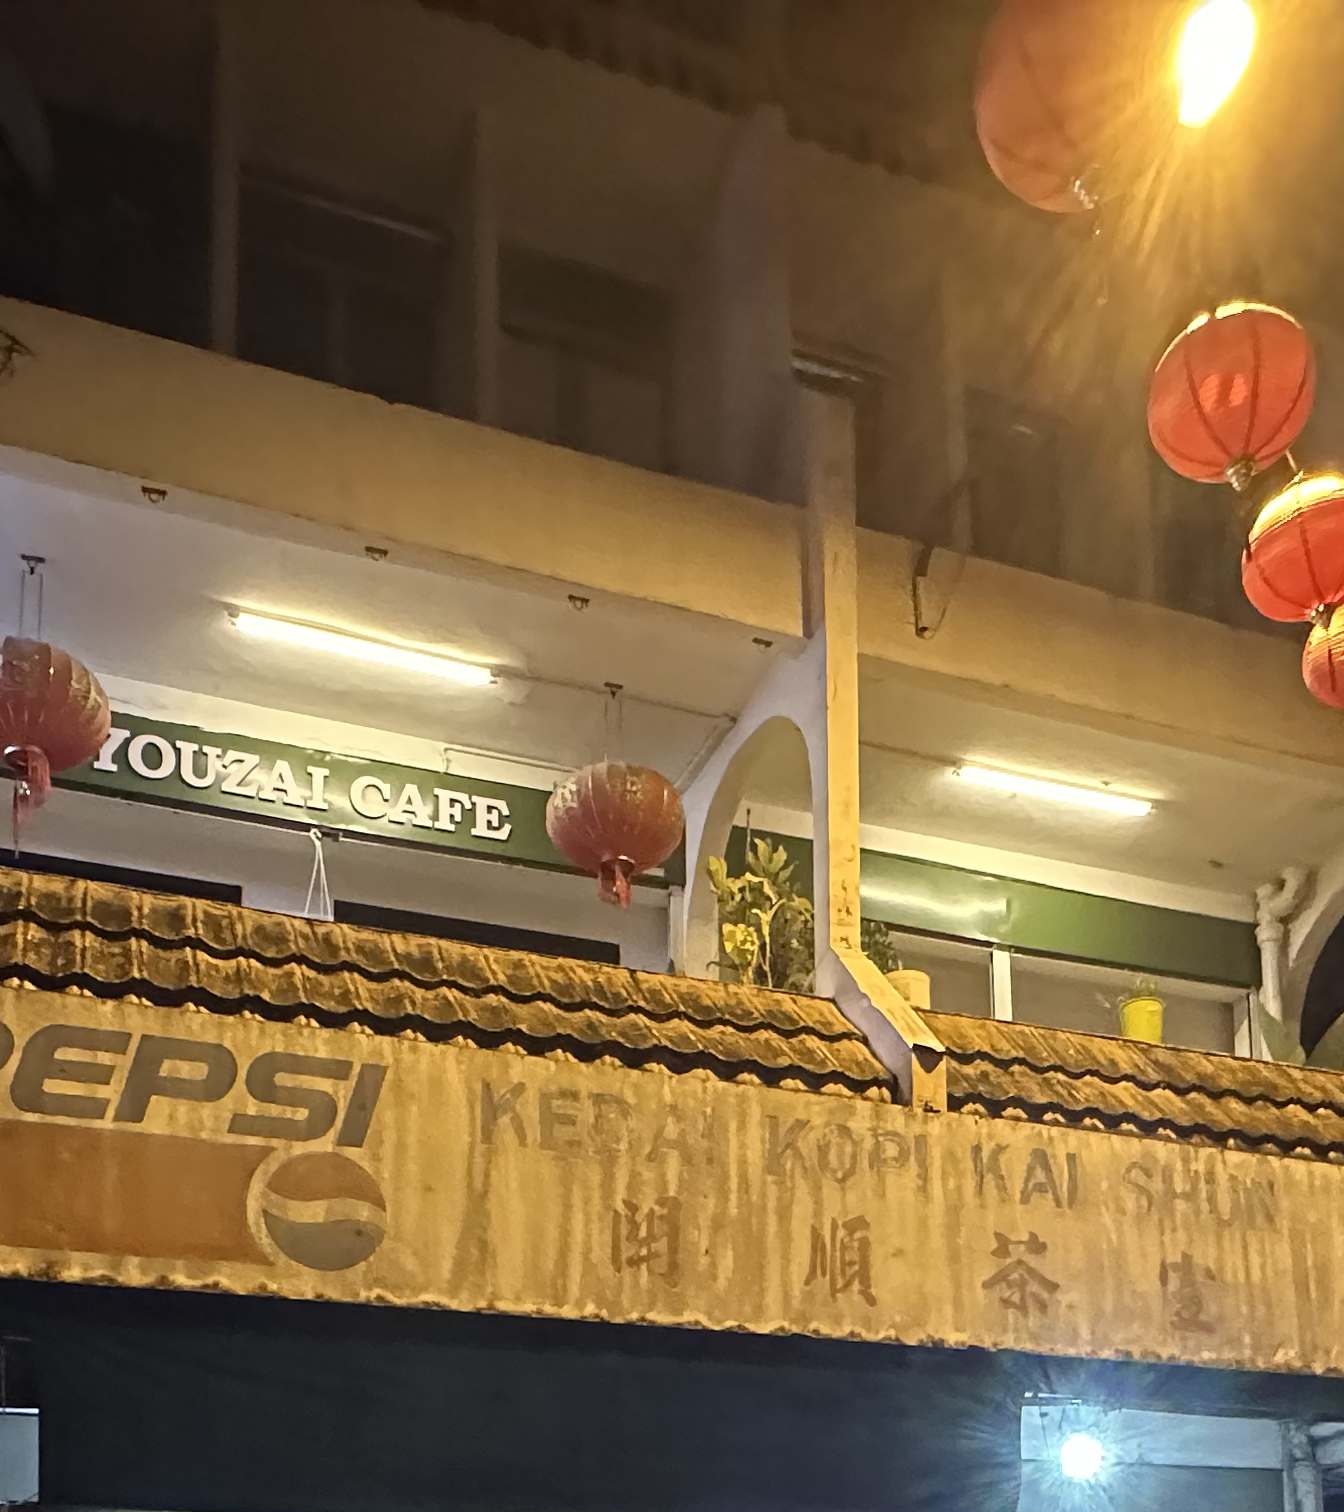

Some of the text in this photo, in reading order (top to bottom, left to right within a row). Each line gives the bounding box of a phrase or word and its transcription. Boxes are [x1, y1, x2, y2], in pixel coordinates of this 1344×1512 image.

[92, 727, 512, 841] YOUZAI CAFE
[764, 1115, 928, 1197] KOPI
[970, 1142, 1079, 1210] KAI
